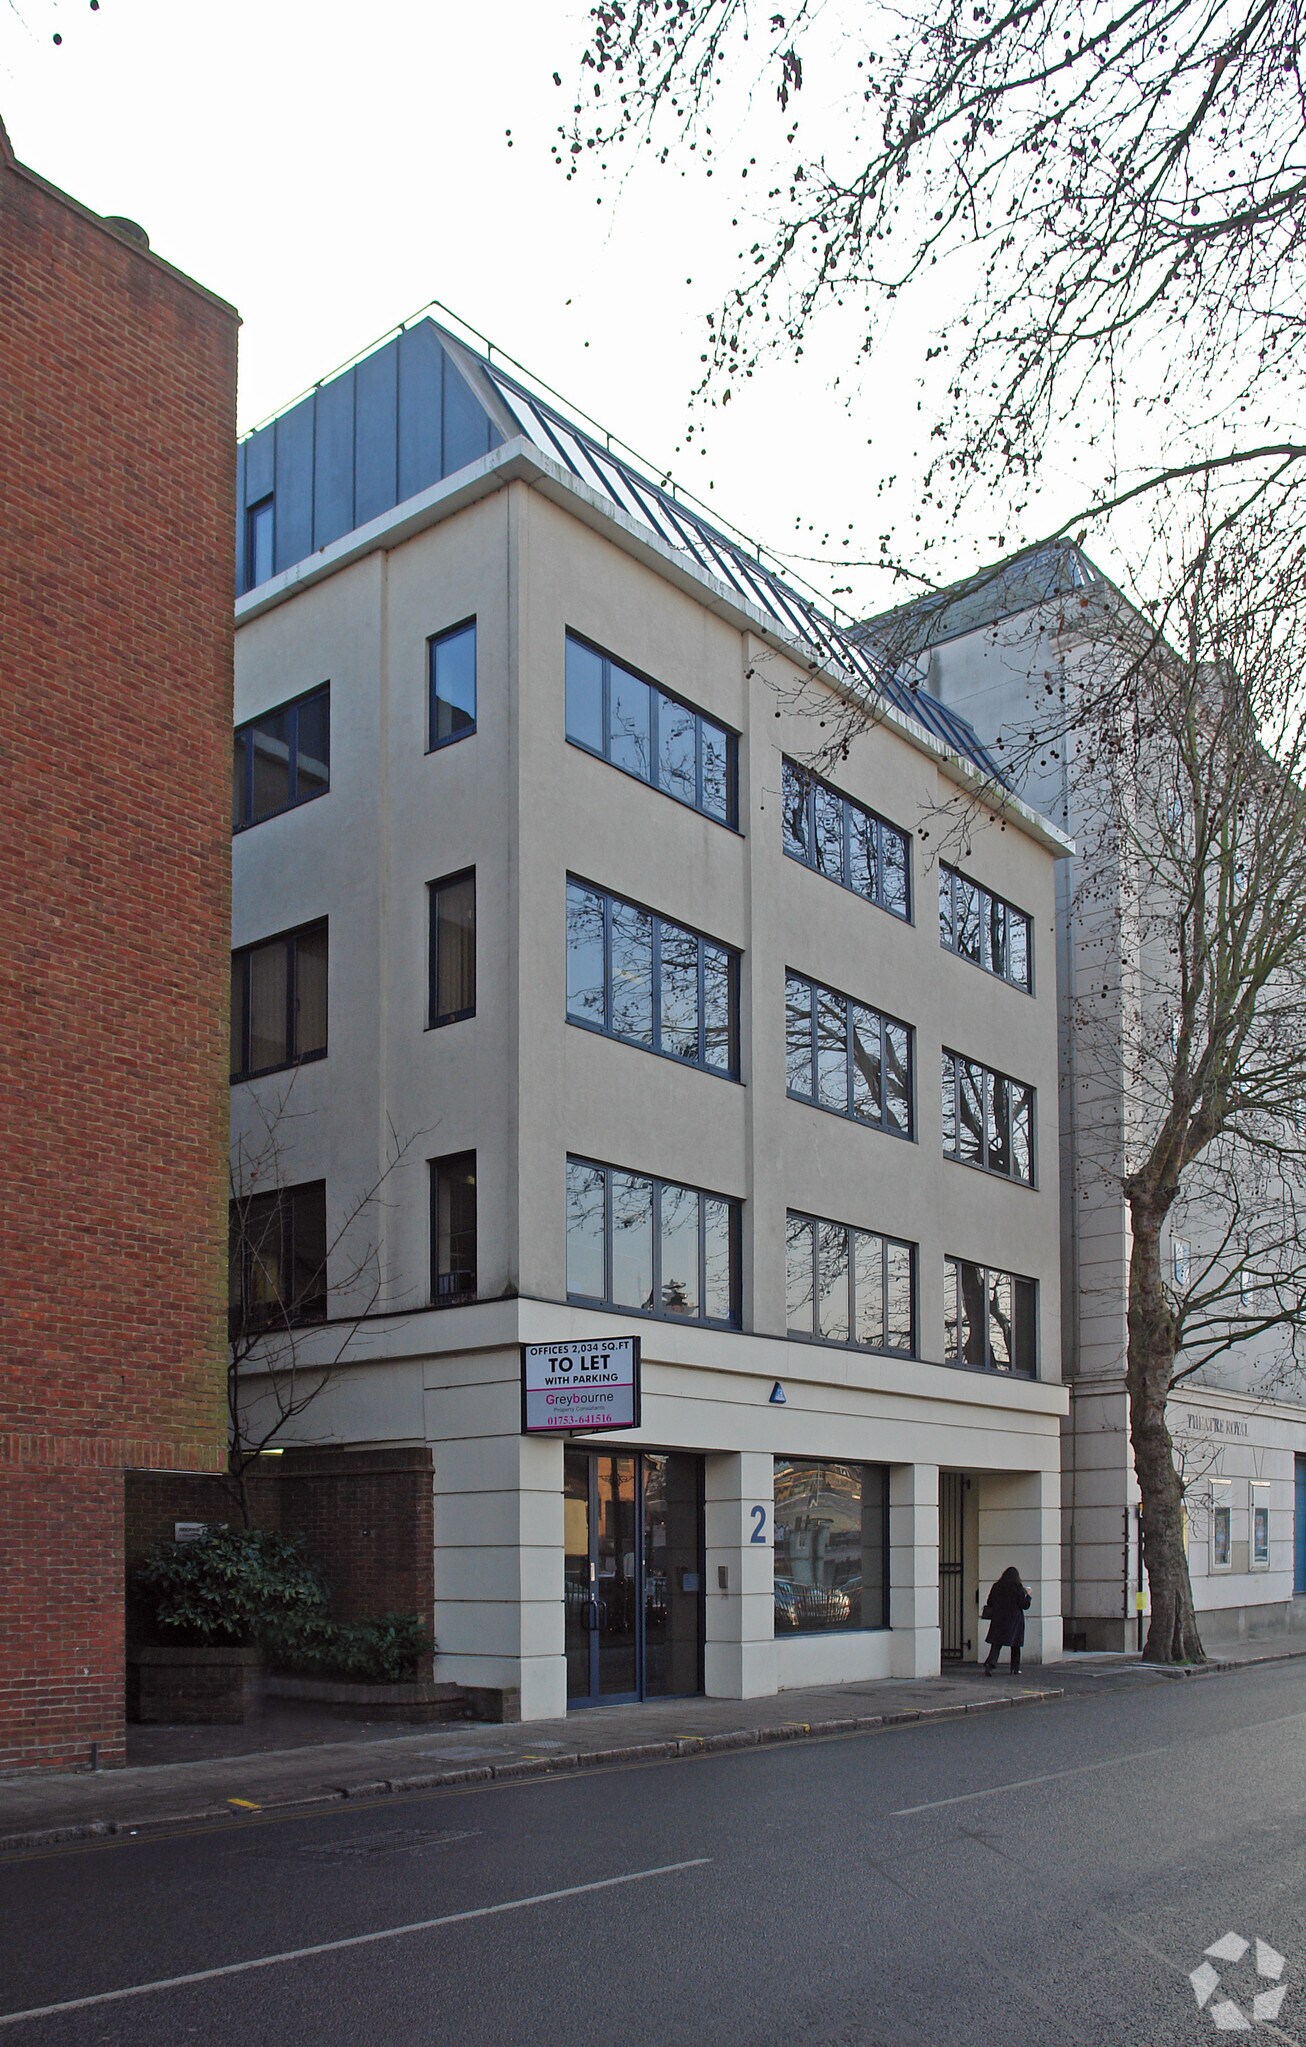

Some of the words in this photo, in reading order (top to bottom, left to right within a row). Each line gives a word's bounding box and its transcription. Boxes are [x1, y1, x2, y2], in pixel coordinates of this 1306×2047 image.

[530, 1345, 569, 1356] OFFICES
[572, 1343, 598, 1354] 2,034
[601, 1341, 629, 1351] SQ.FT
[548, 1357, 574, 1373] TO
[580, 1354, 610, 1371] LET
[544, 1376, 570, 1385] WITH
[573, 1373, 618, 1383] PARKING
[545, 1393, 614, 1406] Greybourne
[547, 1414, 612, 1425] 01753-641516
[1187, 1413, 1224, 1433] THEATRE
[1225, 1420, 1249, 1437] ROYAL
[750, 1505, 766, 1543] 2
